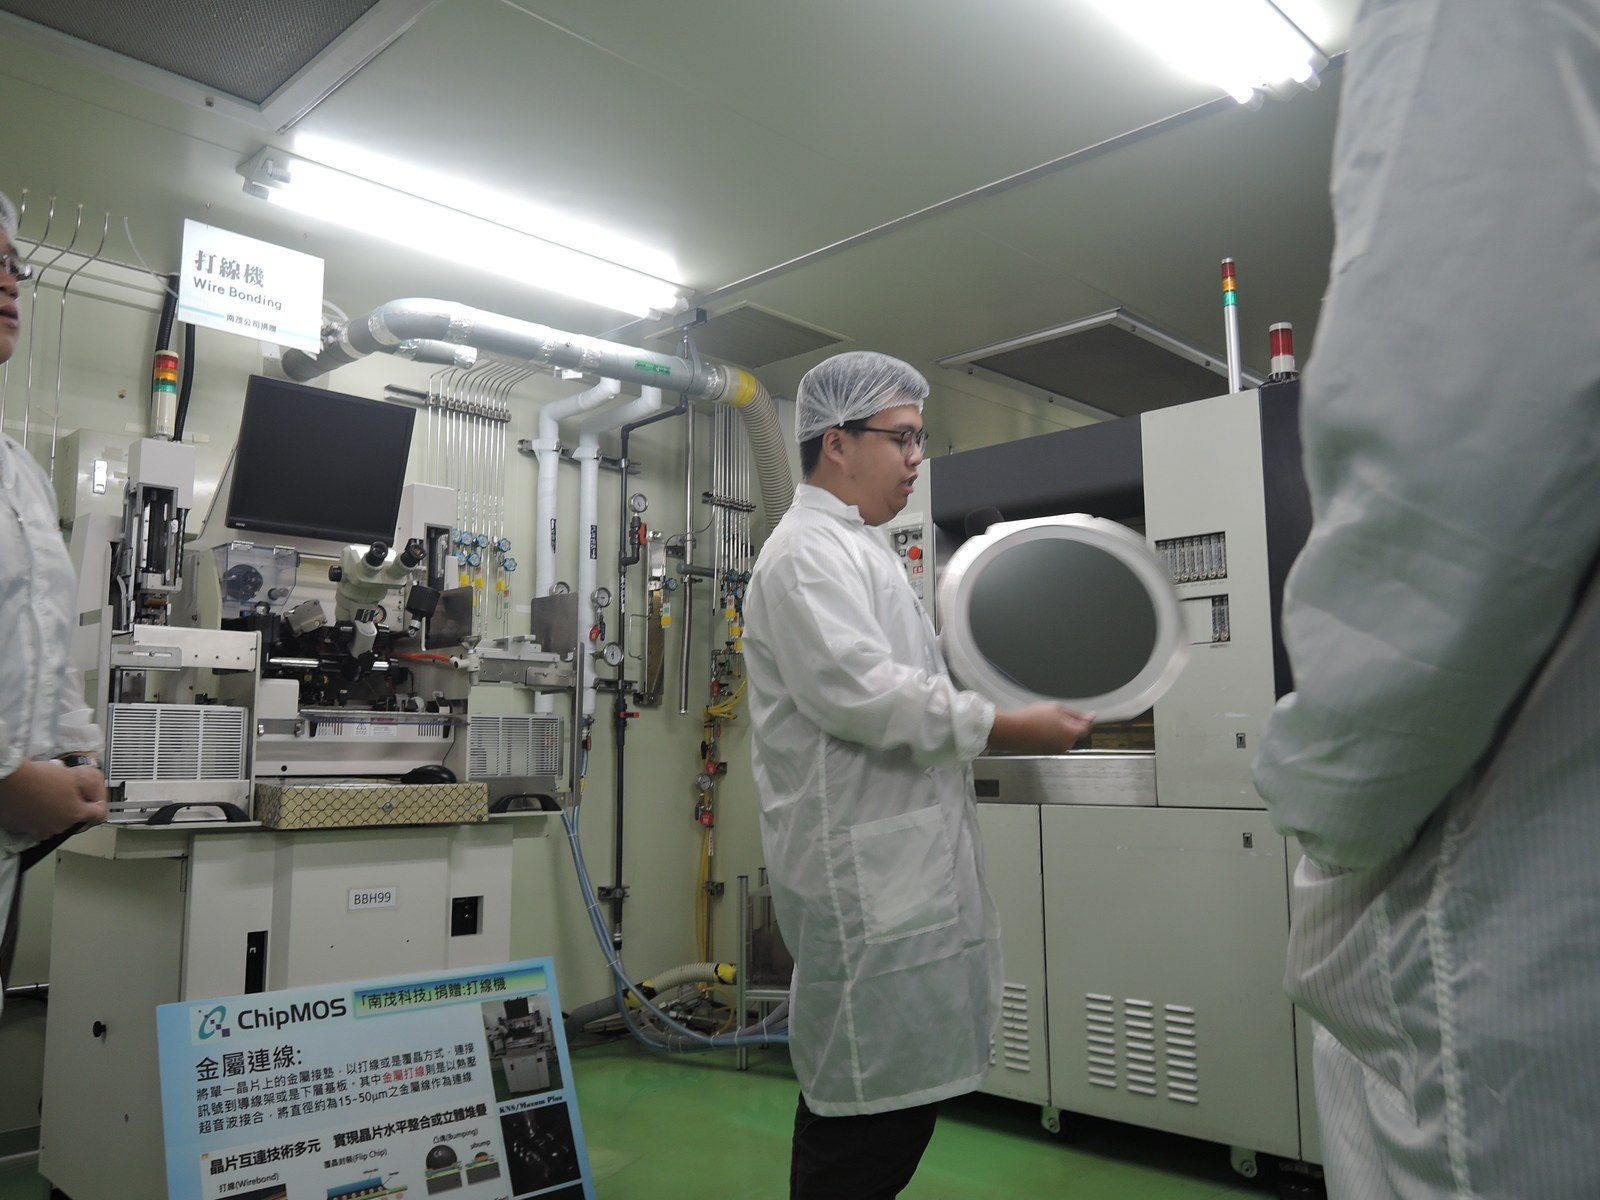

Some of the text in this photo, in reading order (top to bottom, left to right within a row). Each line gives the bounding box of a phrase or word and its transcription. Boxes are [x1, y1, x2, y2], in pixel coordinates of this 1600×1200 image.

[194, 250, 264, 288] 打線機
[193, 276, 283, 311] Wire Bonding
[354, 891, 391, 905] BBH99
[237, 998, 347, 1030] ChipMOS
